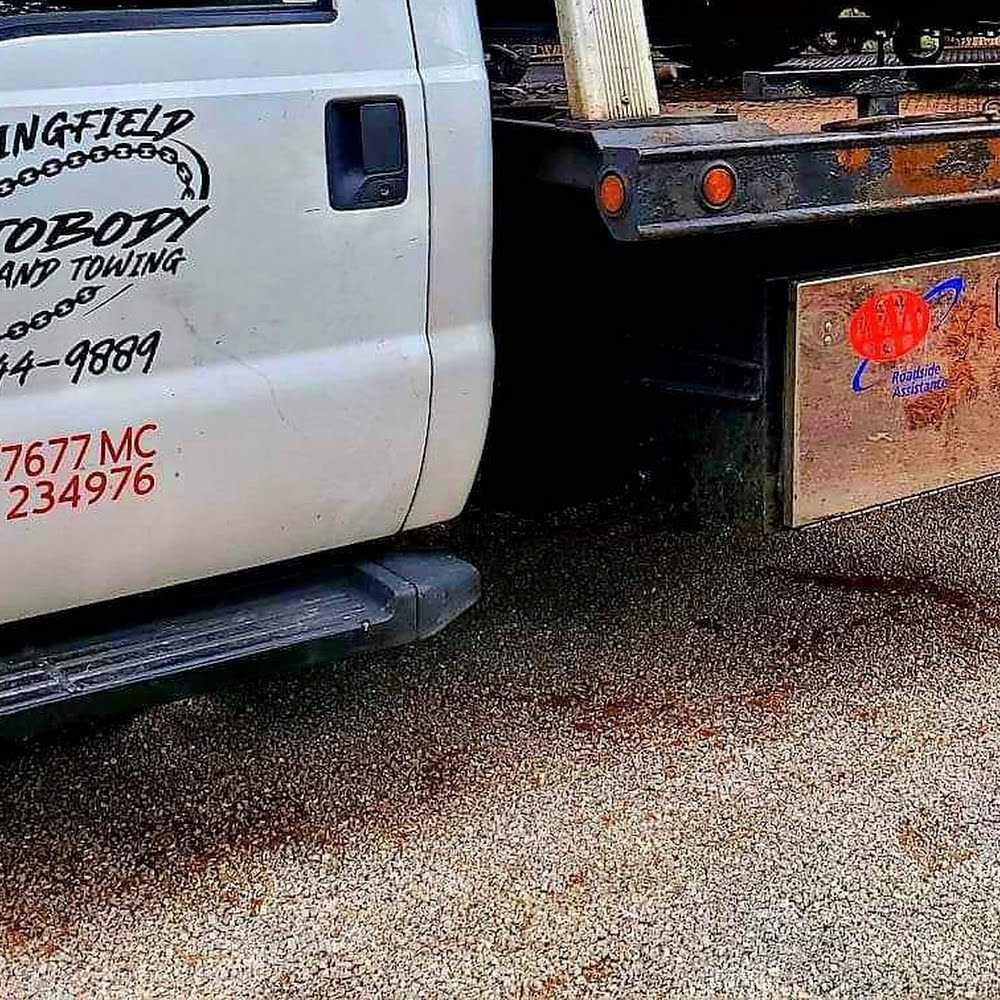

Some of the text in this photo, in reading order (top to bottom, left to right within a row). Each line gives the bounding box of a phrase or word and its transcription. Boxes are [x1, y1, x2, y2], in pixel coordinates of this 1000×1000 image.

[0, 248, 187, 289] AND TOWING
[892, 361, 941, 385] Roadside
[1, 423, 157, 482] 7677 MC
[6, 462, 155, 521] 234976
